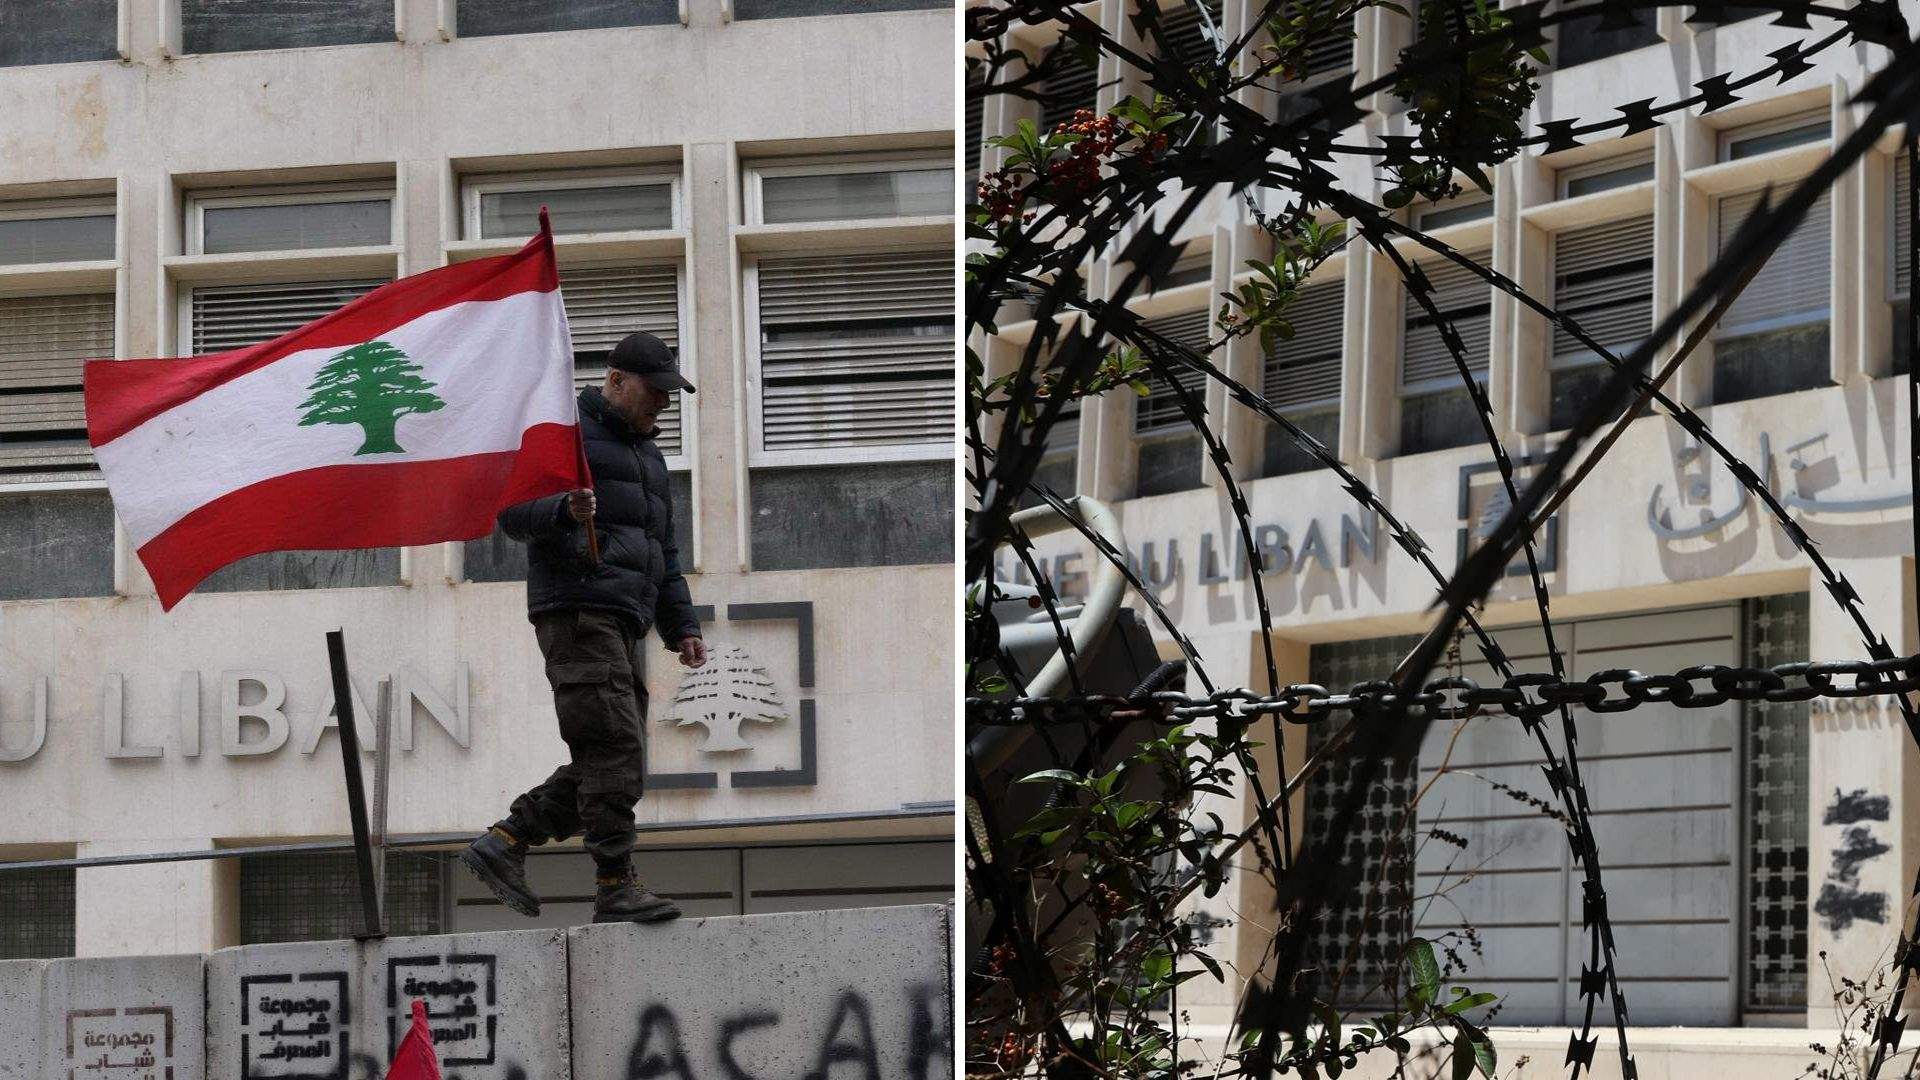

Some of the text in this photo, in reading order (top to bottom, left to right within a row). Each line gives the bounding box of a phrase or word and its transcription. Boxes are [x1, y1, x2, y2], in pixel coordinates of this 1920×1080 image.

[1199, 513, 1378, 586] LIBAN
[104, 661, 471, 760] LIBAN
[403, 977, 477, 999] مجموعة
[259, 996, 331, 1017] مجموعة
[405, 996, 477, 1021] شبا
[84, 1031, 155, 1049] مجموعة
[259, 1040, 331, 1062] المصرف
